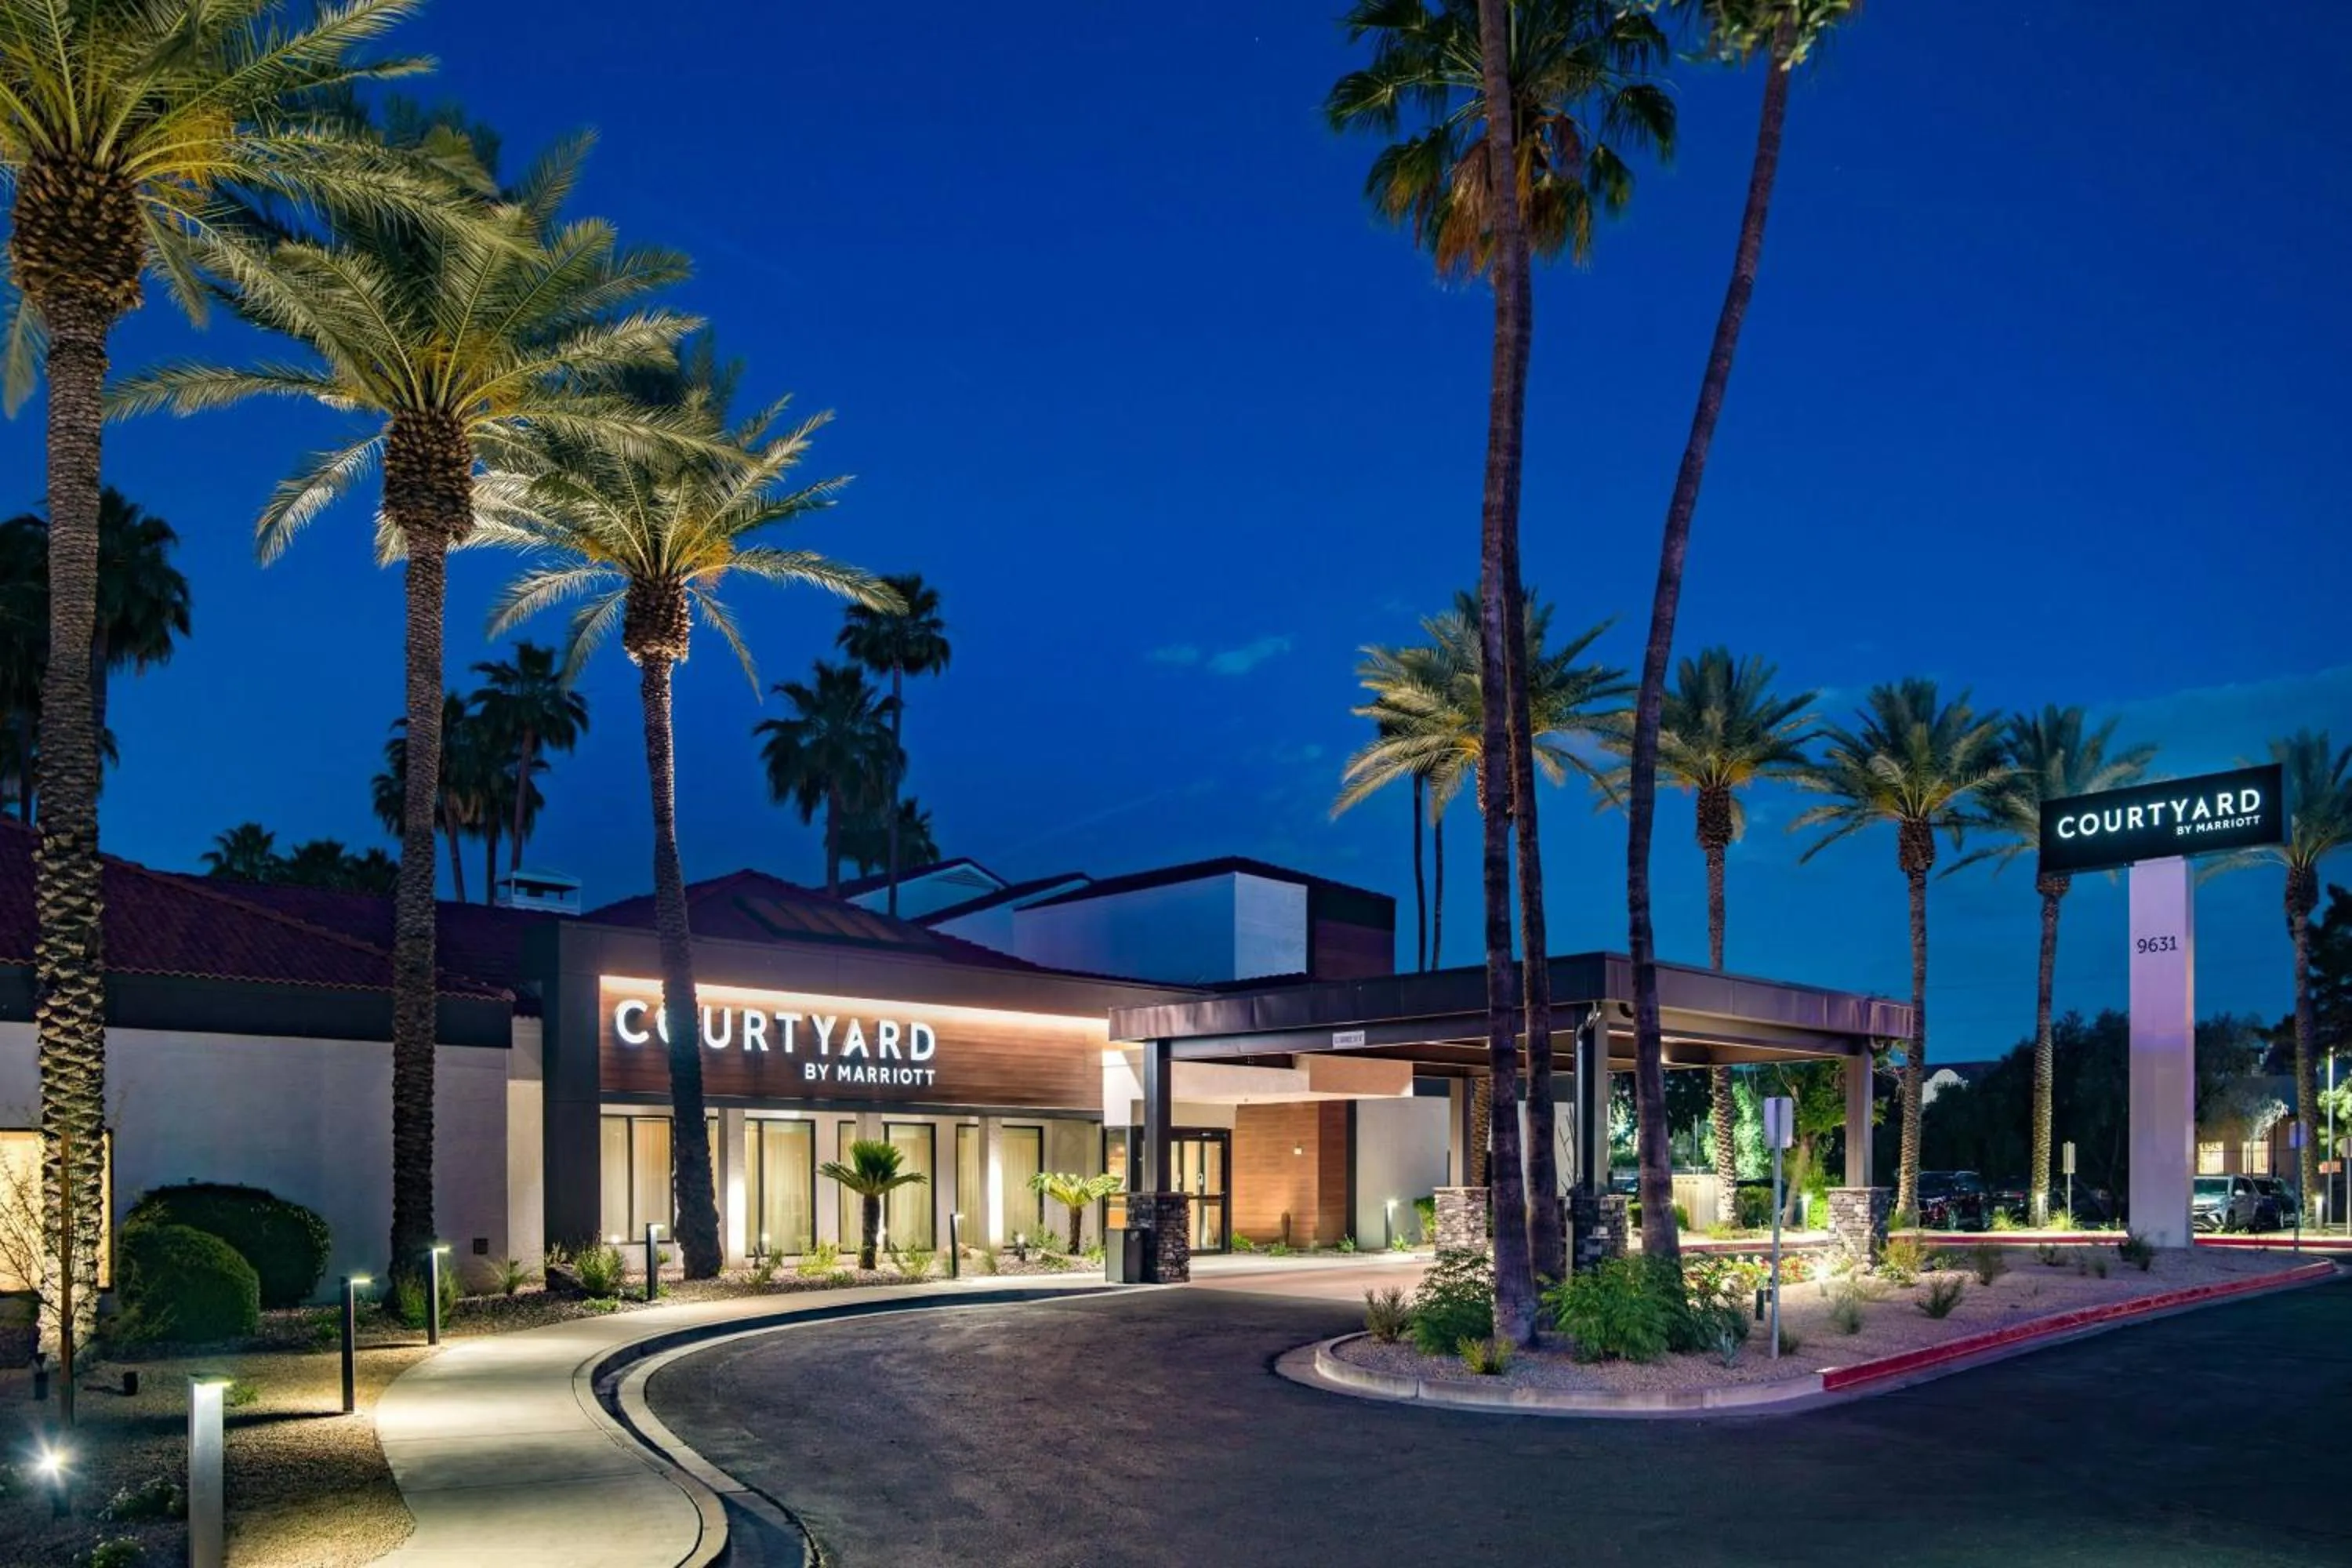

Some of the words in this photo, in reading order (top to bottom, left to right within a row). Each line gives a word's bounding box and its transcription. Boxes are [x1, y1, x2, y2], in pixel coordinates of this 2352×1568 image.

[2057, 789, 2260, 839] COURTYARD
[2176, 824, 2192, 836] BY
[2196, 815, 2261, 833] MARRIOTT
[2136, 936, 2177, 953] 9631
[615, 999, 936, 1062] CURTYARD
[804, 1062, 829, 1080] BY
[837, 1065, 935, 1085] MARRIOTT
